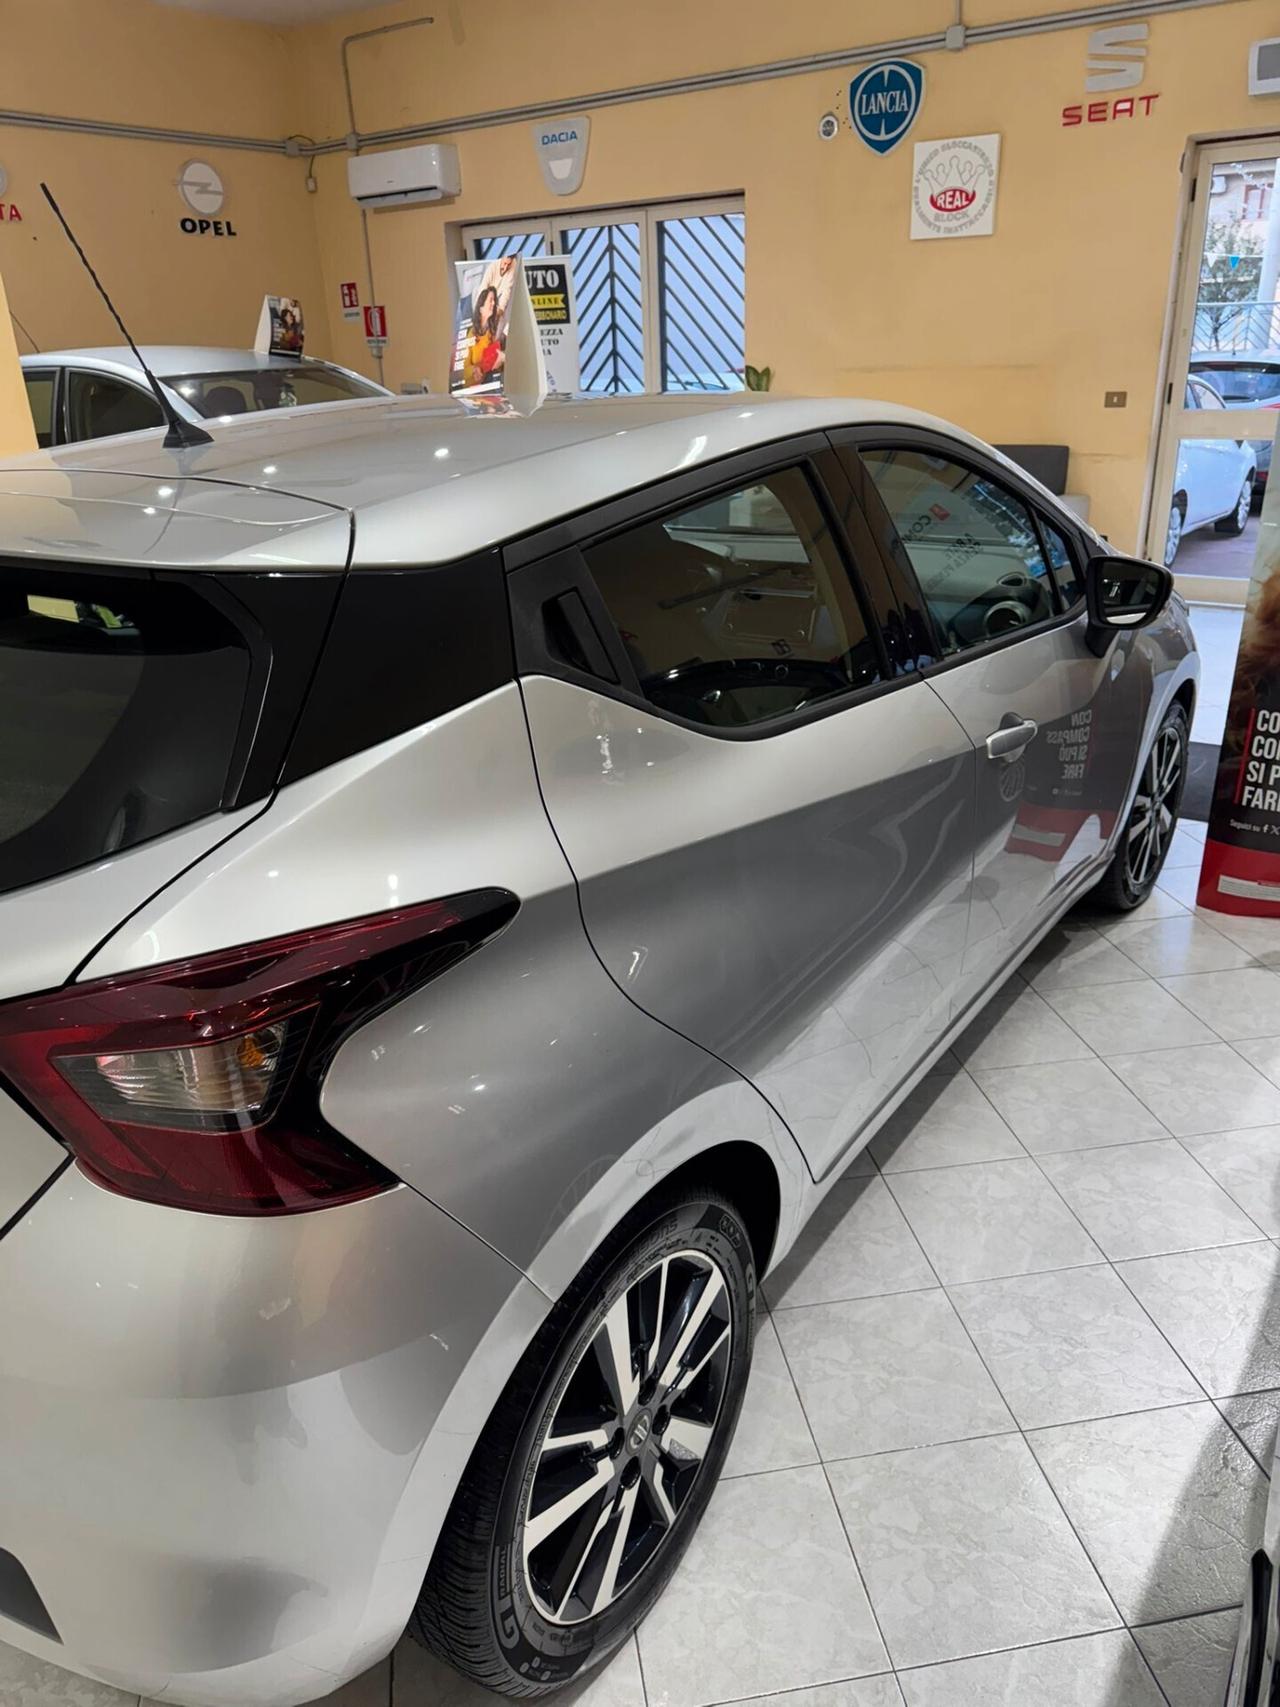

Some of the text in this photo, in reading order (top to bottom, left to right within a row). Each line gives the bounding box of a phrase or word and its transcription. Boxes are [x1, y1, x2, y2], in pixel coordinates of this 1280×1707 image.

[860, 90, 909, 115] LANCIA
[1062, 94, 1160, 127] SEAT
[541, 130, 578, 145] DACIA
[936, 190, 970, 209] REAL
[180, 217, 237, 236] OPEL
[1251, 735, 1280, 760] CO
[1246, 760, 1266, 784] SI
